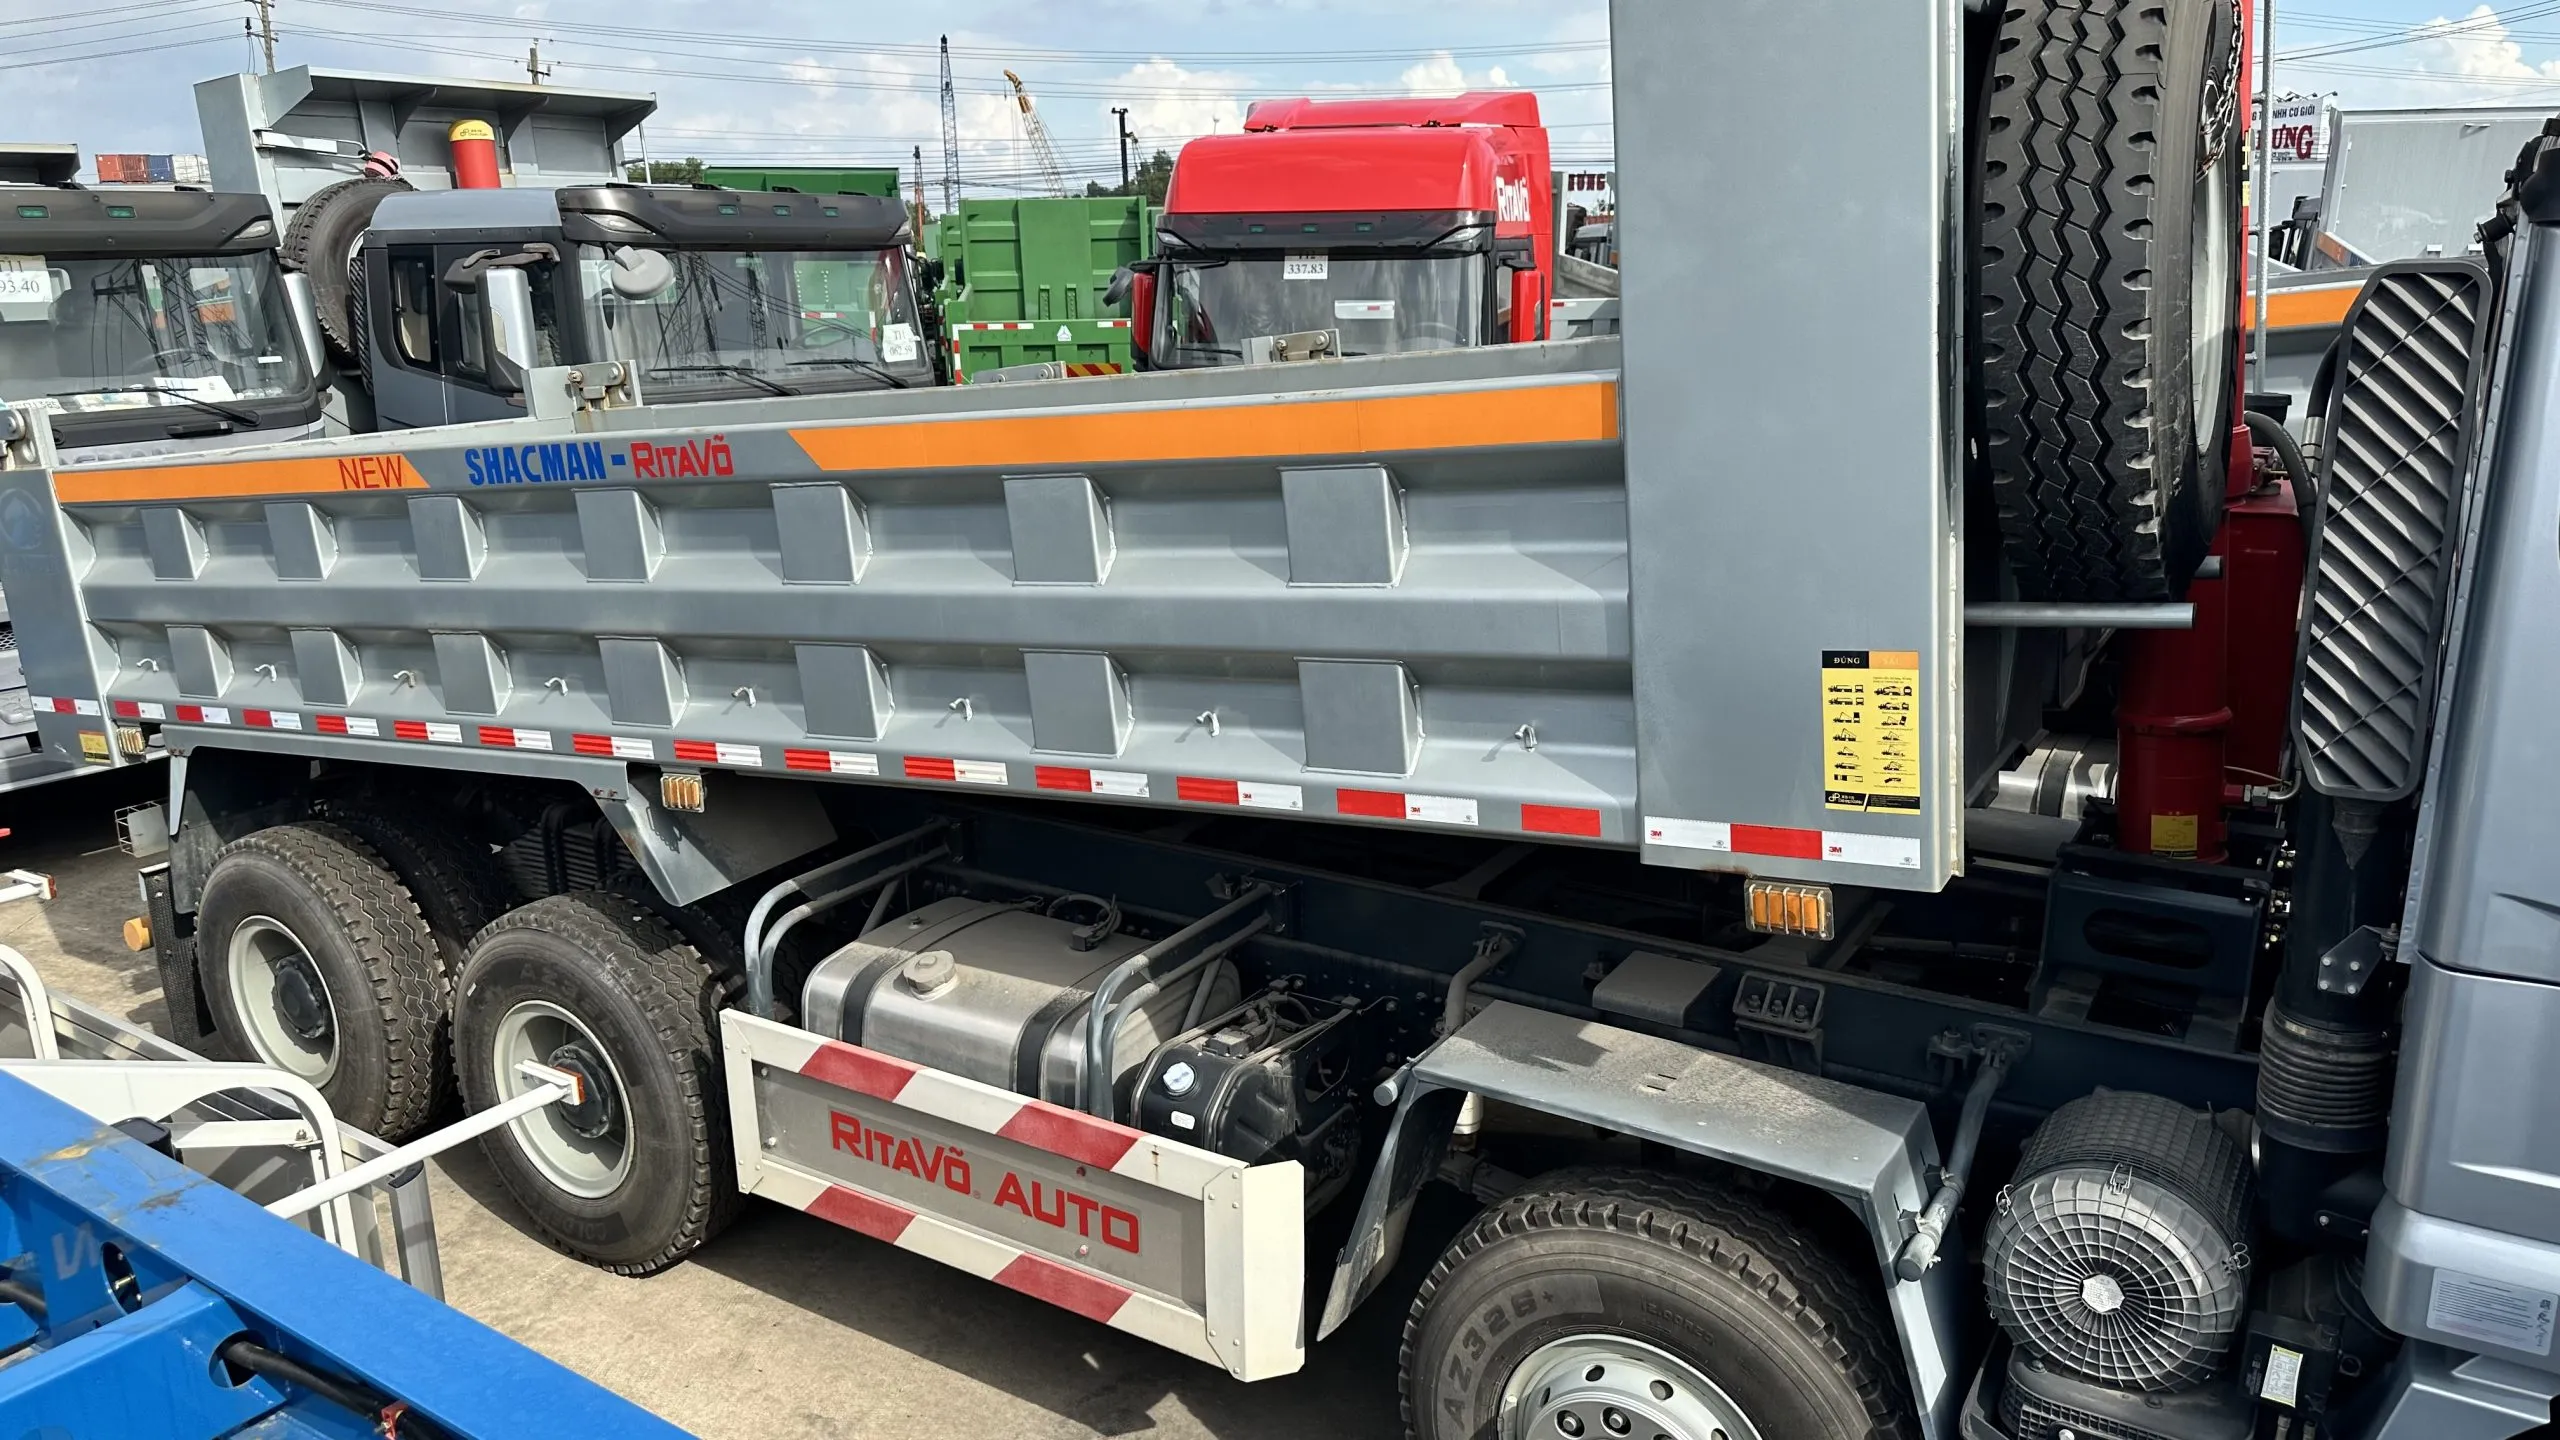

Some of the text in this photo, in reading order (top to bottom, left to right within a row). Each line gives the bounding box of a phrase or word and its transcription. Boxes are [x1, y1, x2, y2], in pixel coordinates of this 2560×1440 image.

[2272, 109, 2287, 119] NHH
[1288, 264, 1324, 274] 337.83
[338, 454, 404, 490] NEW
[465, 441, 607, 486] SHACMAN
[1833, 656, 1860, 664] ĐÚNG
[1829, 846, 1842, 854] 3M
[992, 1171, 1140, 1254] AUTO
